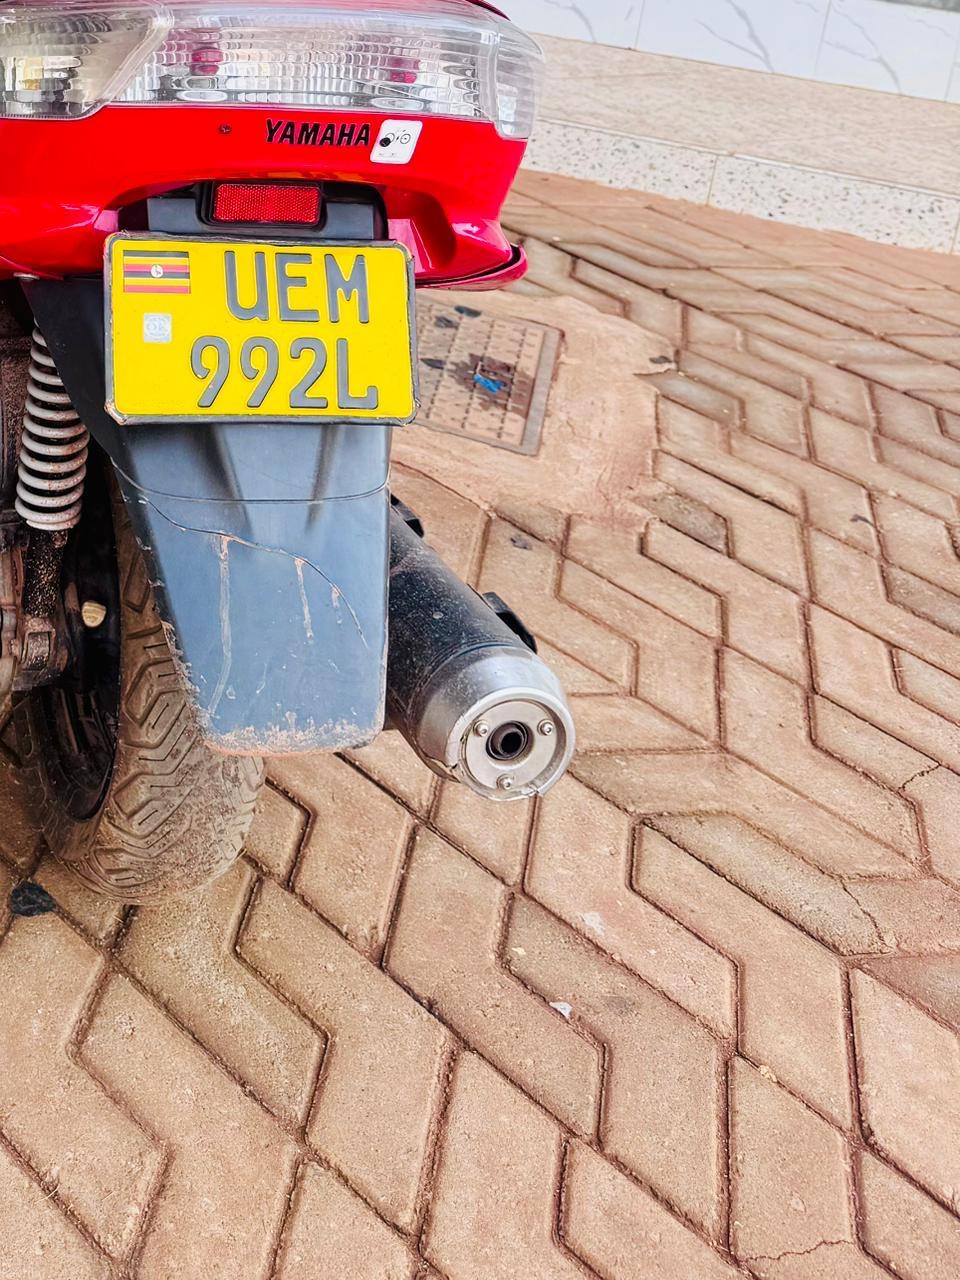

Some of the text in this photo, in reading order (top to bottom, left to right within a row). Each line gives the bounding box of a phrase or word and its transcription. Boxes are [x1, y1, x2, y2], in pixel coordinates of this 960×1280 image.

[266, 119, 371, 146] YAMAHA
[224, 251, 368, 323] UEM
[190, 336, 379, 410] 992L
